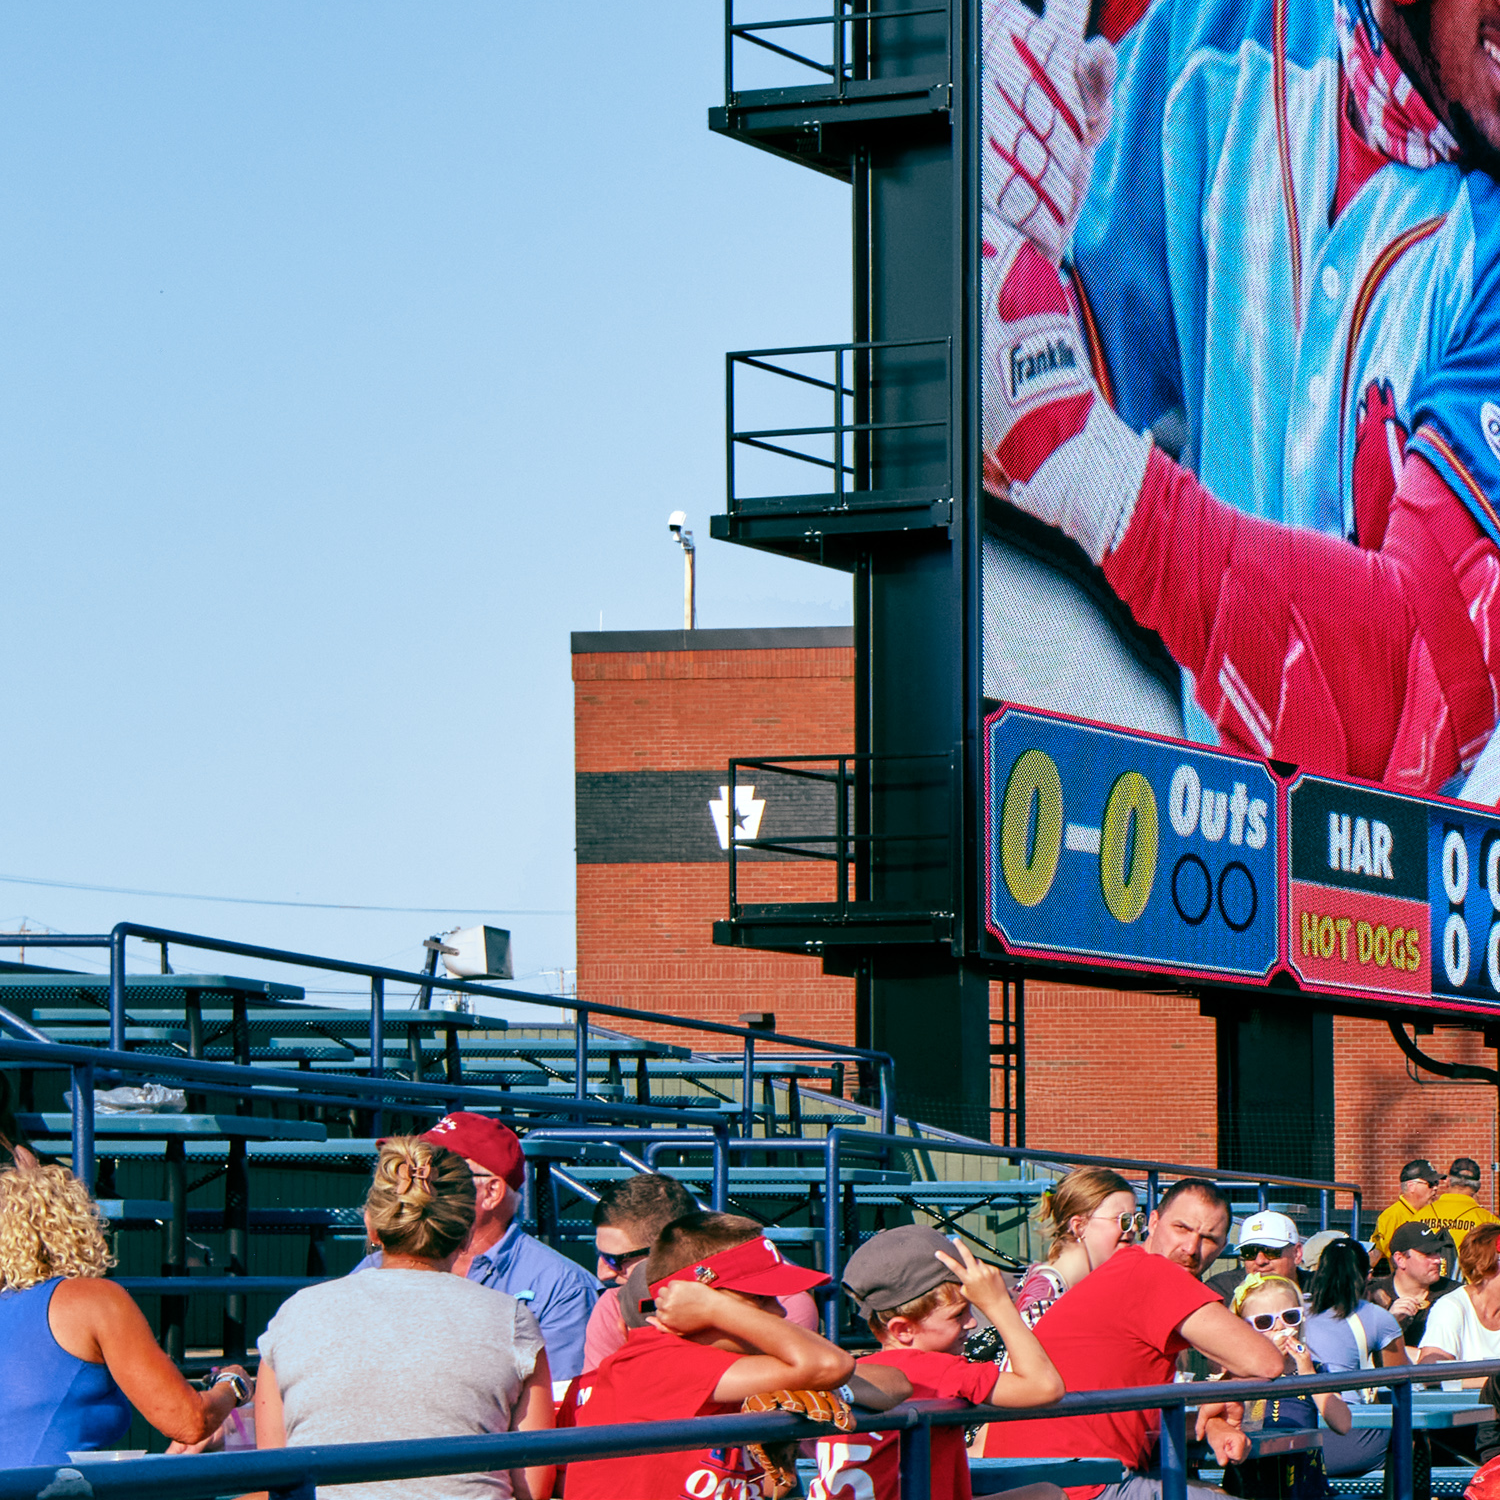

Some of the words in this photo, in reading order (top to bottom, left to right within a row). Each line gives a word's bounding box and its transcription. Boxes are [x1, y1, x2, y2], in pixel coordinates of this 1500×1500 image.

[1168, 765, 1268, 850] Outs
[1328, 812, 1393, 880] HAR
[1300, 912, 1351, 963] HOT
[1356, 920, 1421, 973] DOGS
